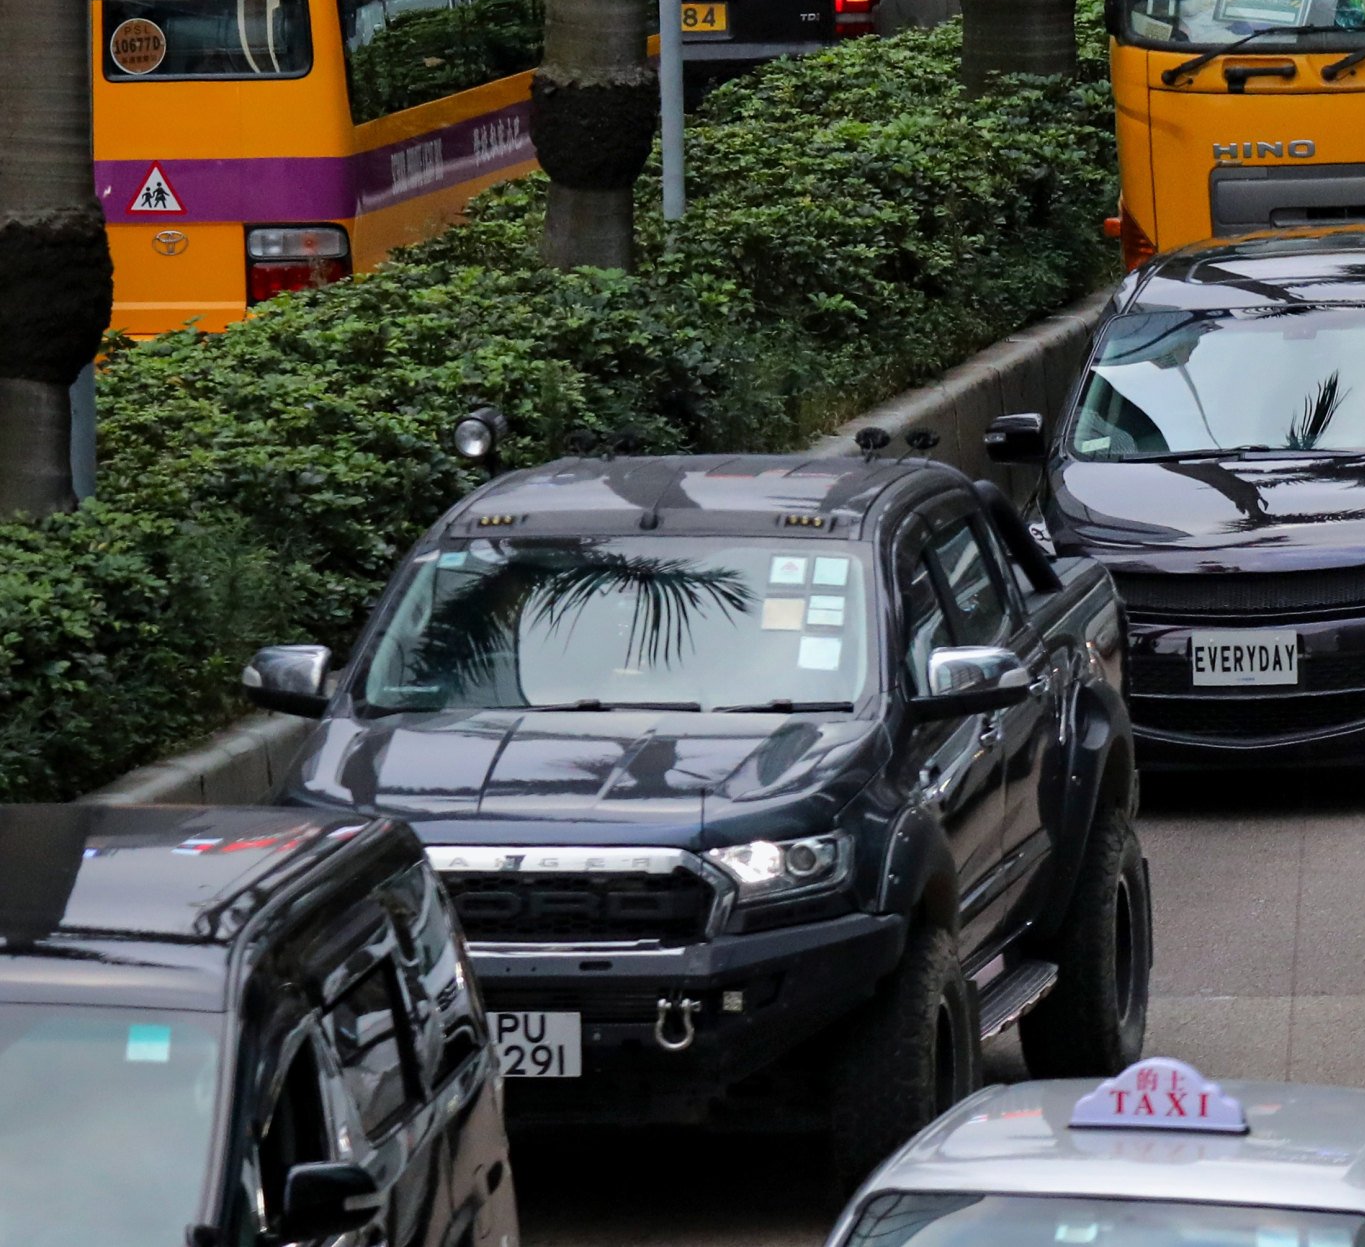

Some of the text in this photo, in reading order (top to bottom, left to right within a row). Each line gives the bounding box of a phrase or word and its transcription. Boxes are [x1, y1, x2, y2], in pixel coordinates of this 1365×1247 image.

[683, 7, 716, 27] 84
[124, 24, 150, 34] PSL
[115, 36, 161, 55] 10677D
[1213, 140, 1316, 159] HINO
[1195, 645, 1296, 673] EVERYDAY
[497, 1014, 546, 1043] PU
[1136, 1068, 1183, 1091] 的士
[1110, 1090, 1211, 1117] TAXI
